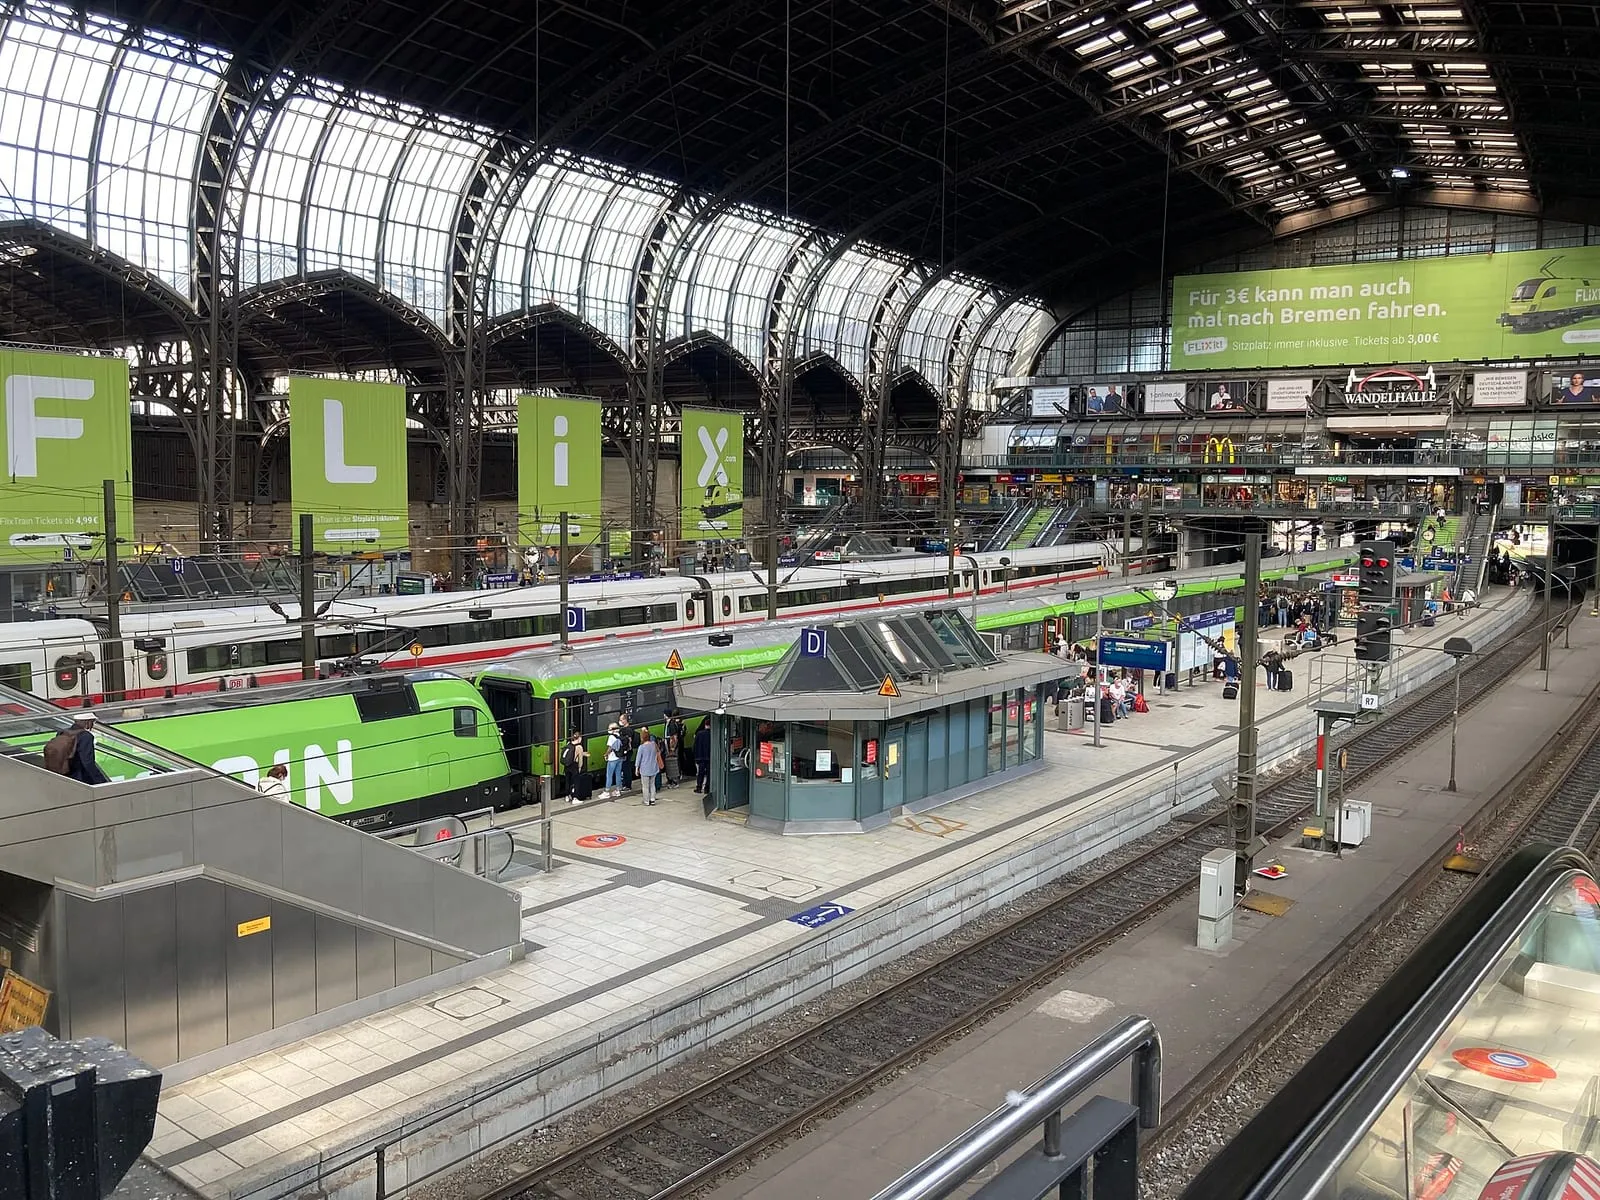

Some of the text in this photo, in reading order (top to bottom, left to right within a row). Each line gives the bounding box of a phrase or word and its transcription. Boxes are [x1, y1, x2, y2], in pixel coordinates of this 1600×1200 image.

[1189, 277, 1411, 306] Für 3€ kann man auch
[1188, 301, 1447, 328] mal nach Bremen fahren.
[1232, 340, 1272, 351] Sitzplatz
[1274, 339, 1304, 350] immer
[1354, 335, 1390, 346] Tickets
[1392, 334, 1406, 344] ab
[1407, 333, 1440, 345] 3,00€
[1344, 392, 1436, 404] WANDELHALLE
[6, 375, 95, 477] F
[324, 399, 377, 484] L
[698, 426, 728, 488] X
[36, 516, 62, 524] Tickets
[232, 646, 238, 654] 2
[808, 632, 820, 653] D
[1366, 696, 1374, 705] R7
